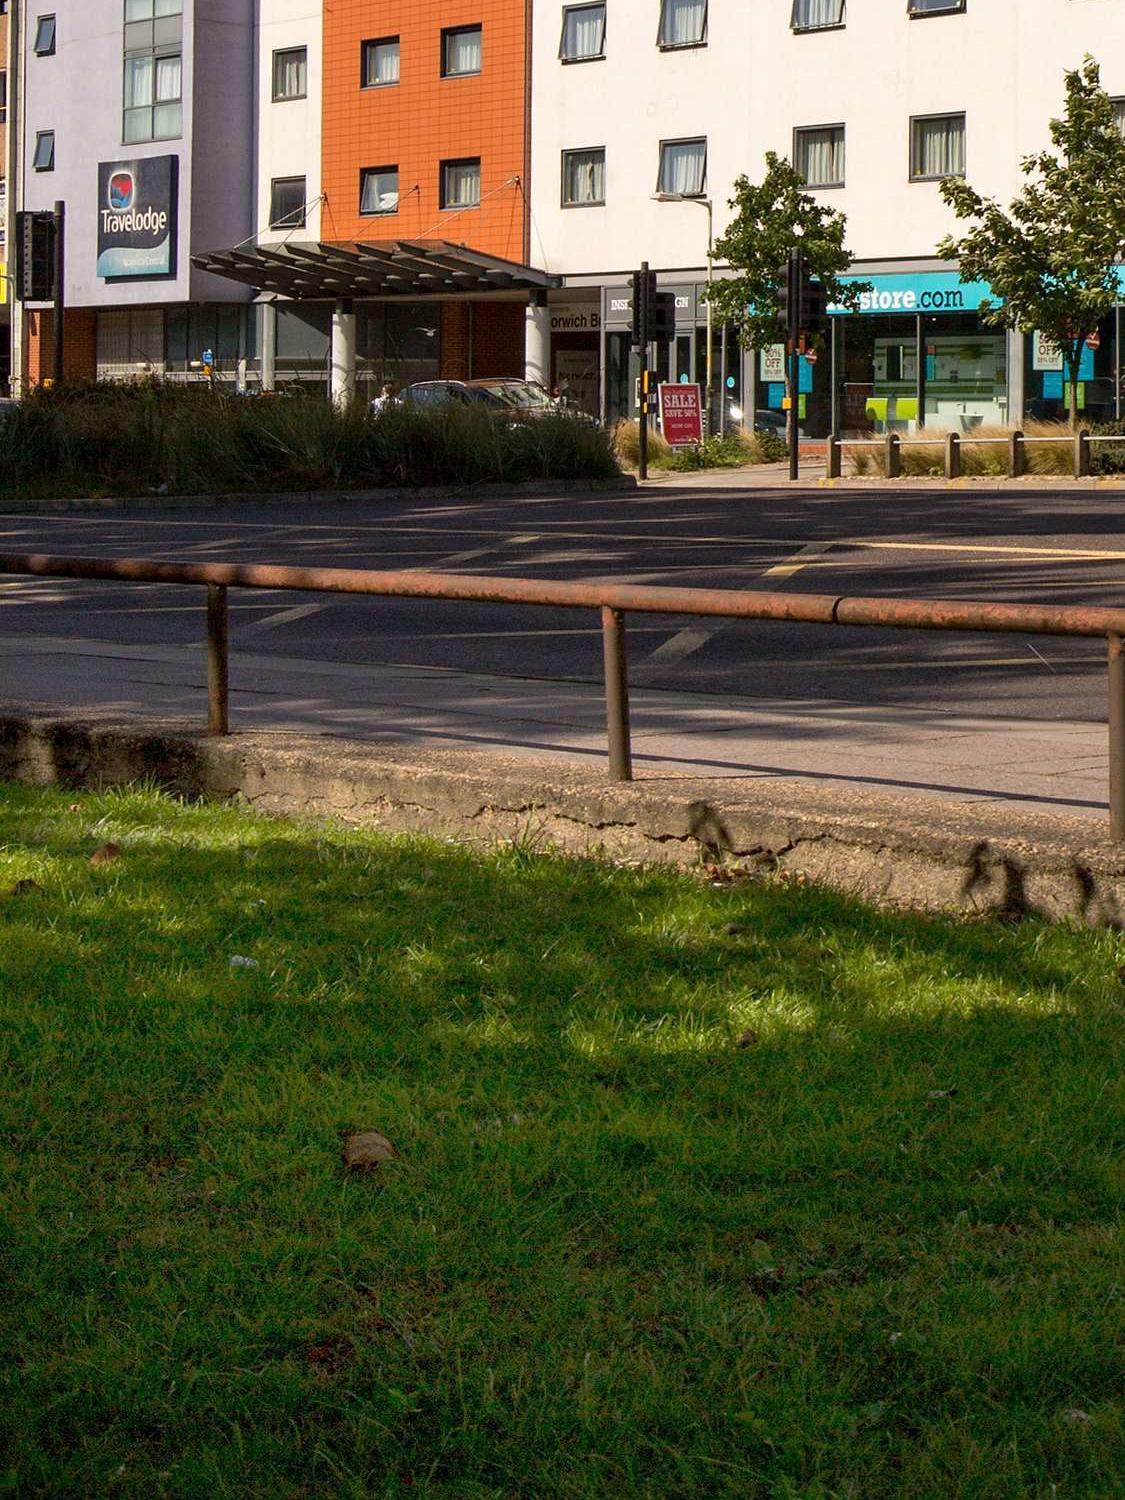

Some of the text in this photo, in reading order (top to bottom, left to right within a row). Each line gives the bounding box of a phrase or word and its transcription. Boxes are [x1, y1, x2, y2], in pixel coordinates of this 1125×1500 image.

[101, 206, 167, 235] Travelodge
[551, 313, 587, 328] orwich
[765, 358, 781, 368] OFF
[664, 394, 697, 408] SALE
[665, 409, 683, 418] SAVE
